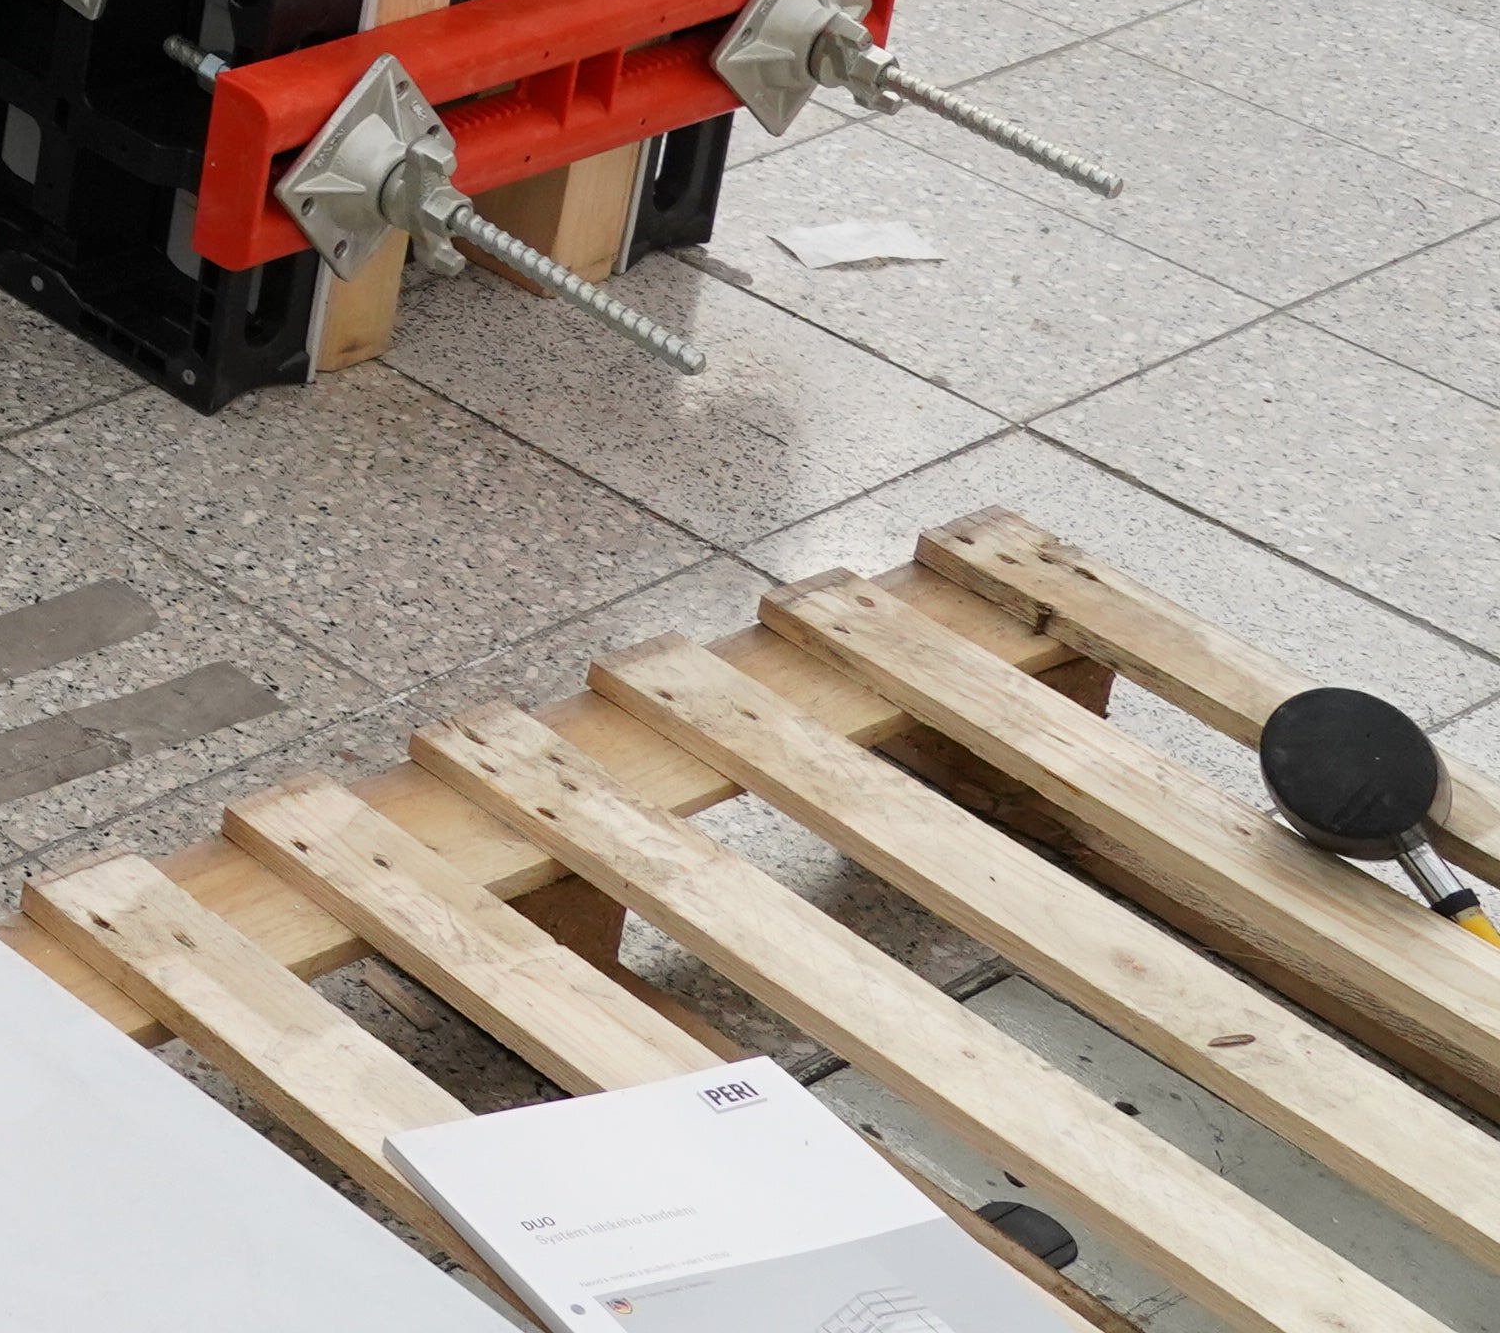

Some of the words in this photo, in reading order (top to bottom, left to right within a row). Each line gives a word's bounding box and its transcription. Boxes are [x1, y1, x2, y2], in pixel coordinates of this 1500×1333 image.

[704, 1079, 760, 1107] PERI
[520, 1215, 556, 1233] DUO
[534, 1226, 589, 1247] Systém
[588, 1213, 642, 1235] lehkého
